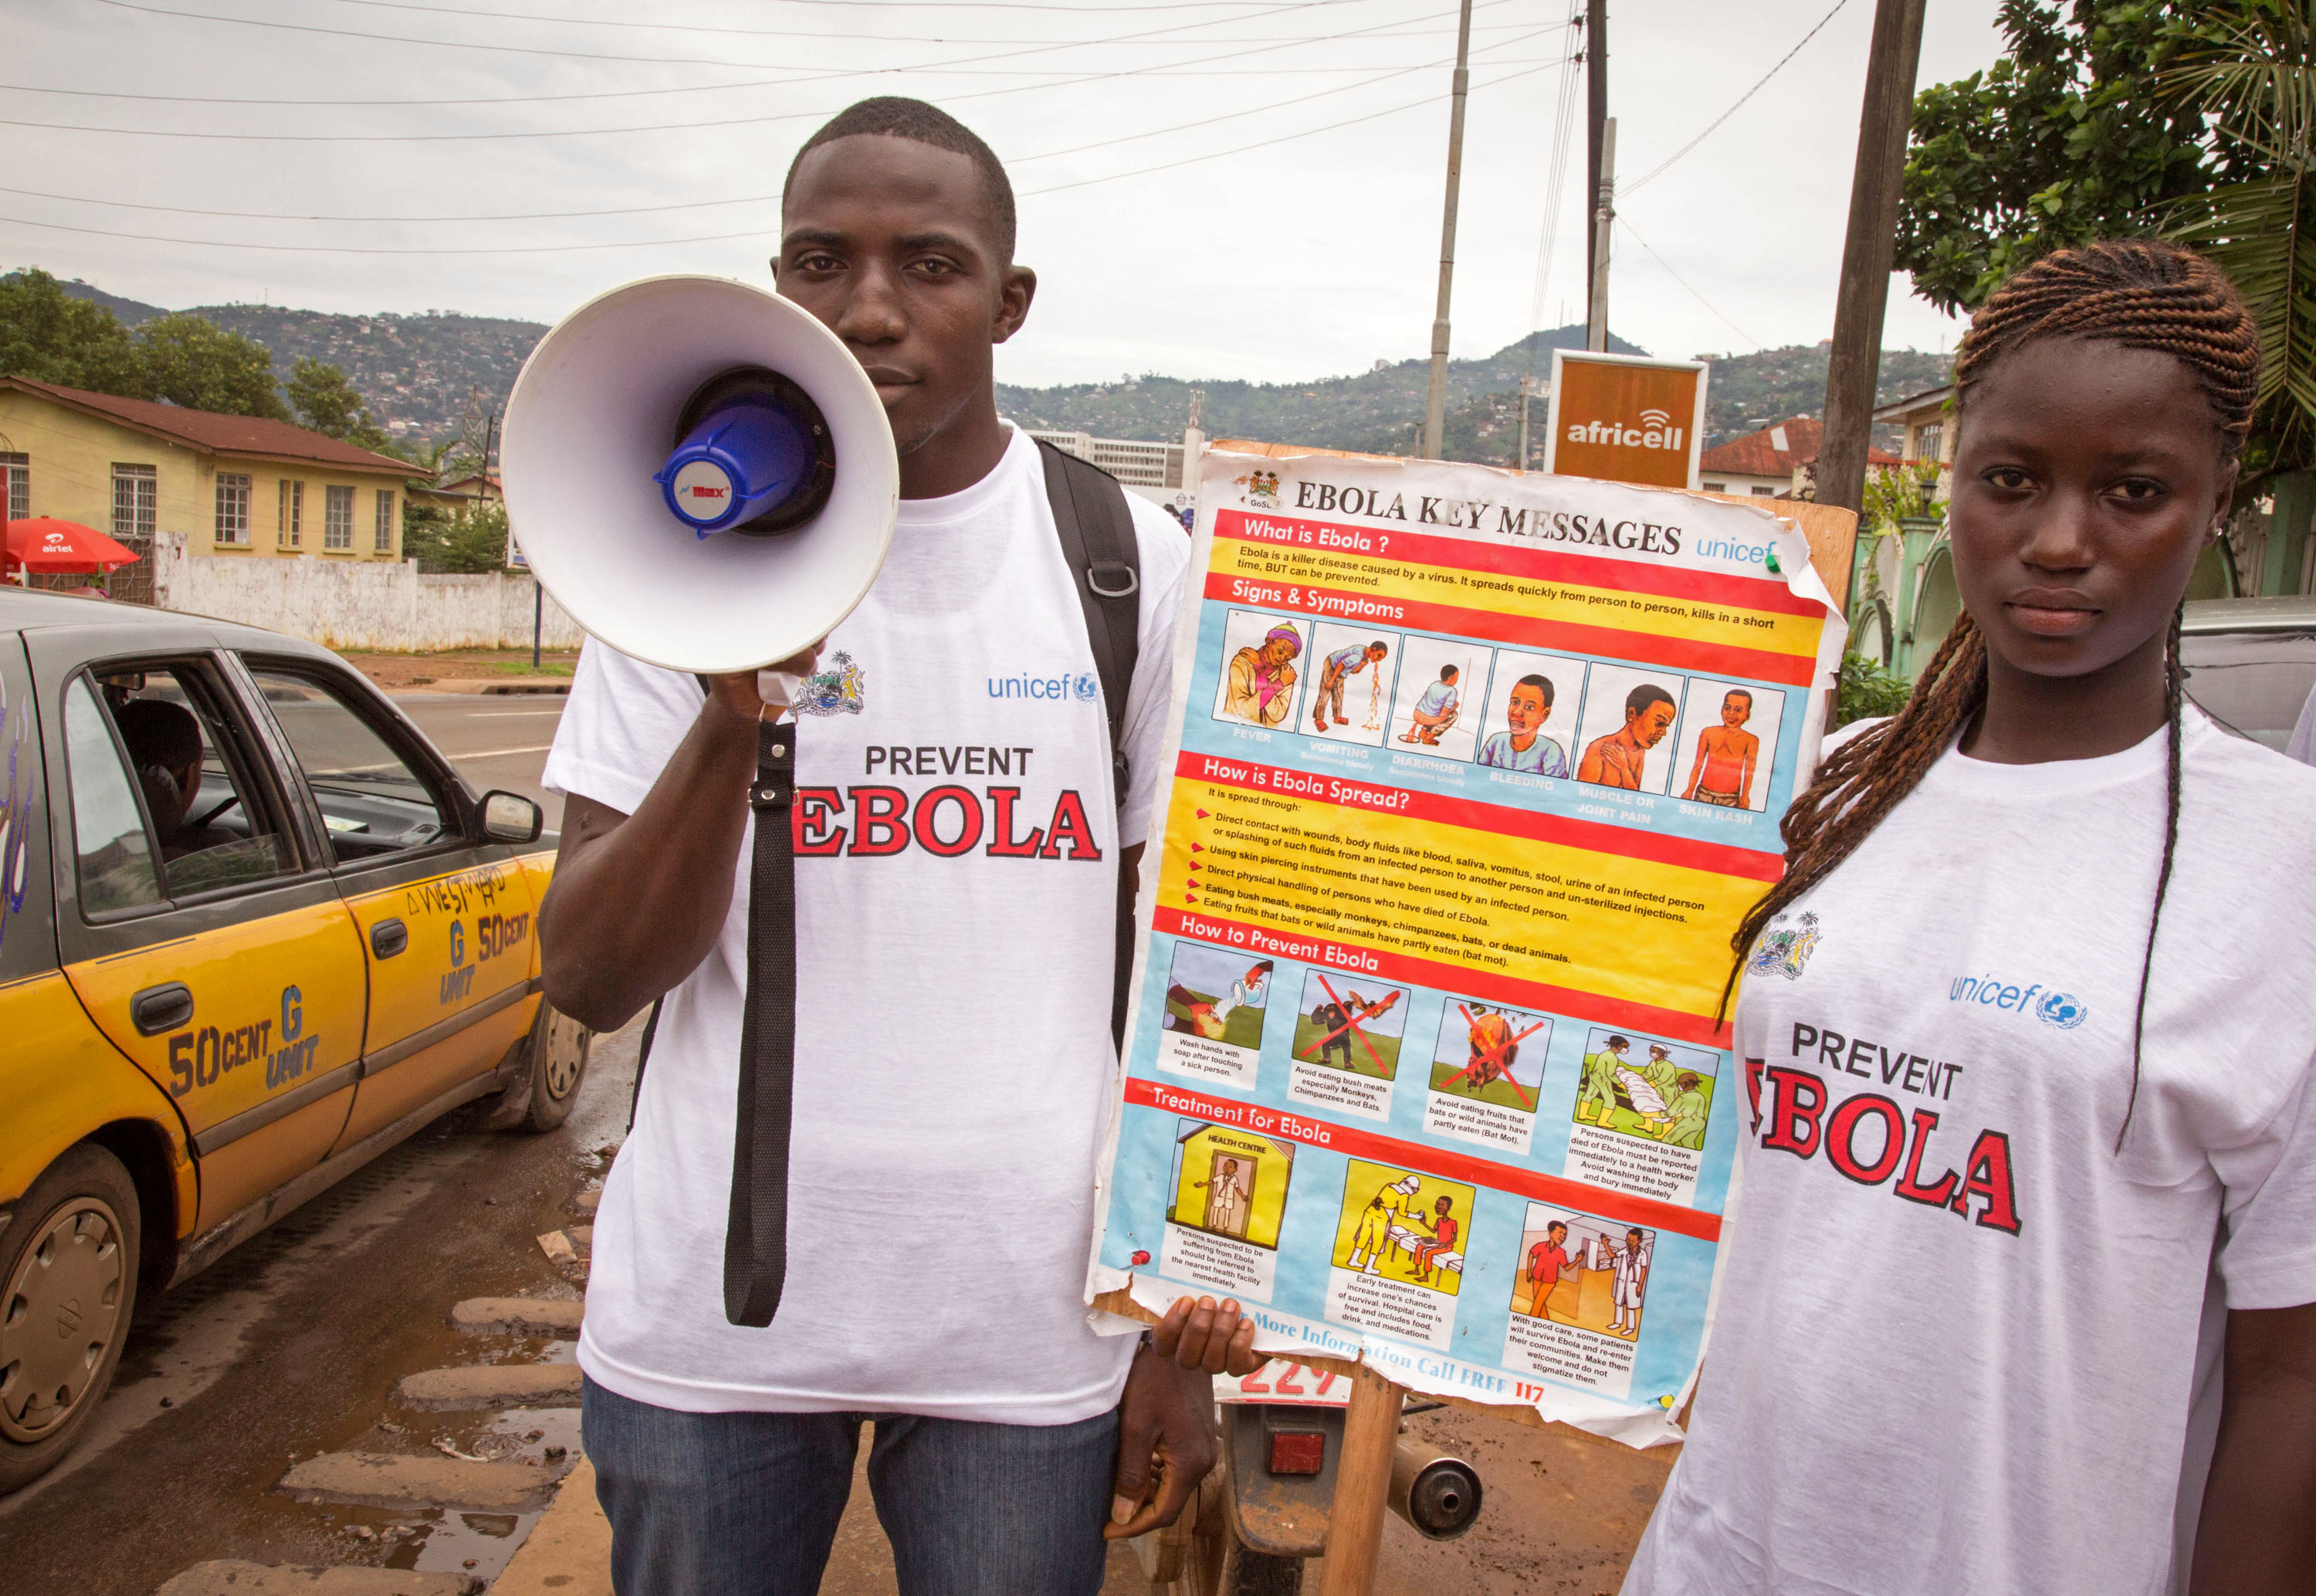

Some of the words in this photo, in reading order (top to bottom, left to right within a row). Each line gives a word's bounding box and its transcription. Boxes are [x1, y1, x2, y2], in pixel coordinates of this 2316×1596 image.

[1567, 421, 1683, 451] africell
[1295, 481, 1407, 521] EBOLA
[1417, 496, 1490, 530] KEY
[1496, 506, 1681, 556] MESSAGES
[1244, 518, 1294, 541] What
[1298, 524, 1312, 543] is
[1318, 528, 1371, 551] Ebola
[1379, 536, 1390, 553] ?
[1697, 536, 1776, 567] unicef
[1238, 558, 1262, 572] time,
[1265, 562, 1288, 574] BUT
[1289, 567, 1308, 577] can
[1309, 568, 1322, 579] be
[1324, 572, 1380, 587] prevented.
[1231, 579, 1282, 603] Signs
[1287, 587, 1301, 605] &
[1306, 590, 1404, 620] Symptoms
[1240, 546, 1269, 559] Ebola
[1271, 550, 1281, 560] is
[1292, 553, 1317, 565] killer
[1319, 556, 1359, 570] disease
[1361, 564, 1400, 577] caused
[1402, 568, 1417, 581] by
[1428, 572, 1458, 584] virus.
[1461, 576, 1468, 586] It
[1470, 579, 1515, 592] spreads
[1517, 586, 1558, 600] quickly
[1560, 590, 1586, 602] from
[1588, 596, 1627, 608] person
[1630, 599, 1642, 610] to
[1644, 603, 1688, 618] person,
[1691, 607, 1715, 620] kills
[1718, 611, 1730, 622] in
[1732, 616, 1740, 624] a
[1742, 616, 1775, 630] short
[988, 673, 1071, 701] unicef
[1233, 728, 1271, 743] FEVER
[1309, 740, 1369, 759] VOMITING
[866, 746, 1034, 776] PREVENT
[1392, 754, 1464, 776] DIARRHOEA
[1204, 758, 1248, 781] How
[1252, 766, 1267, 785] is
[1272, 770, 1324, 795] Ebola
[1329, 780, 1410, 810] Spread?
[1489, 771, 1554, 791] BLEEDING
[1208, 787, 1216, 796] It
[1217, 789, 1226, 798] is
[1227, 793, 1260, 805] spread
[1261, 797, 1302, 813] through:
[1578, 785, 1633, 805] MUSCLE
[1636, 796, 1655, 809] OR
[794, 785, 1102, 863] EBOLA
[1576, 803, 1617, 819] JOINT
[1620, 810, 1651, 824] PAIN
[1679, 803, 1712, 819] SKIN
[1715, 810, 1753, 825] RASH
[1215, 812, 1244, 826] Direct
[1245, 820, 1279, 832] contact
[1281, 826, 1301, 836] with
[1303, 830, 1343, 845] wounds,
[1346, 836, 1371, 850] body
[1373, 840, 1400, 854] fluids
[1403, 846, 1420, 857] like
[1422, 850, 1453, 865] blood,
[1455, 858, 1487, 871] saliva,
[1490, 864, 1532, 880] vomitus,
[1535, 872, 1563, 886] stool,
[1566, 878, 1592, 890] urine
[1594, 883, 1607, 892] of
[1607, 887, 1620, 895] an
[1624, 888, 1666, 904] infected
[1667, 898, 1705, 911] person
[1207, 864, 1235, 877] Direct
[1236, 871, 1276, 886] physical
[1278, 877, 1319, 895] handling
[1320, 888, 1332, 896] of
[1332, 890, 1372, 904] persons
[1374, 898, 1396, 908] who
[1397, 901, 1421, 913] have
[1423, 906, 1445, 918] died
[1446, 911, 1458, 920] of
[1458, 912, 1490, 927] Ebola.
[450, 919, 464, 968] G
[1181, 915, 1222, 938] How
[1227, 926, 1244, 944] to
[1251, 929, 1319, 959] Prevent
[1324, 945, 1379, 971] Ebola
[440, 964, 476, 1006] UNIT
[1949, 974, 2042, 1013] unicef
[282, 984, 302, 1042] G
[266, 1033, 320, 1090] UNIT
[1173, 1048, 1191, 1059] soap
[1192, 1052, 1210, 1061] after
[1210, 1056, 1243, 1071] touching
[1180, 1038, 1200, 1049] Wash
[1200, 1043, 1224, 1054] hands
[1224, 1050, 1240, 1058] with
[1791, 1023, 1963, 1102] PREVENT
[1187, 1061, 1203, 1070] sick
[1203, 1065, 1231, 1077] person.
[1153, 1087, 1243, 1122] Treatment
[1248, 1108, 1275, 1129] for
[1280, 1116, 1331, 1144] Ebola
[1207, 1134, 1238, 1148] HEALTH
[1238, 1141, 1267, 1155] CENTRE
[1580, 1160, 1605, 1172] Avoid
[1606, 1168, 1640, 1183] washing
[1642, 1175, 1656, 1185] the
[1657, 1178, 1679, 1192] body
[1583, 1173, 1600, 1182] and
[1600, 1175, 1620, 1189] bury
[1621, 1181, 1672, 1201] immediately
[1192, 1270, 1237, 1290] immediately.
[1356, 1274, 1376, 1287] Early
[1378, 1280, 1416, 1295] treatment
[1417, 1290, 1431, 1300] can
[1346, 1283, 1380, 1297] increase
[1381, 1293, 1403, 1302] one's
[1404, 1297, 1437, 1311] chances
[1342, 1313, 1363, 1325] drink,
[1365, 1320, 1381, 1328] and
[1382, 1324, 1431, 1341] medications.
[1253, 1312, 1297, 1338] More
[1302, 1324, 1411, 1369] Information
[1417, 1357, 1454, 1381] Call
[1459, 1368, 1507, 1395] FREE
[1515, 1381, 1545, 1403] 117
[1527, 1351, 1563, 1365] welcome
[1564, 1361, 1580, 1370] and
[1581, 1364, 1592, 1373] do
[1593, 1368, 1608, 1378] not
[1532, 1363, 1574, 1378] stigmatize
[1575, 1373, 1598, 1385] them.
